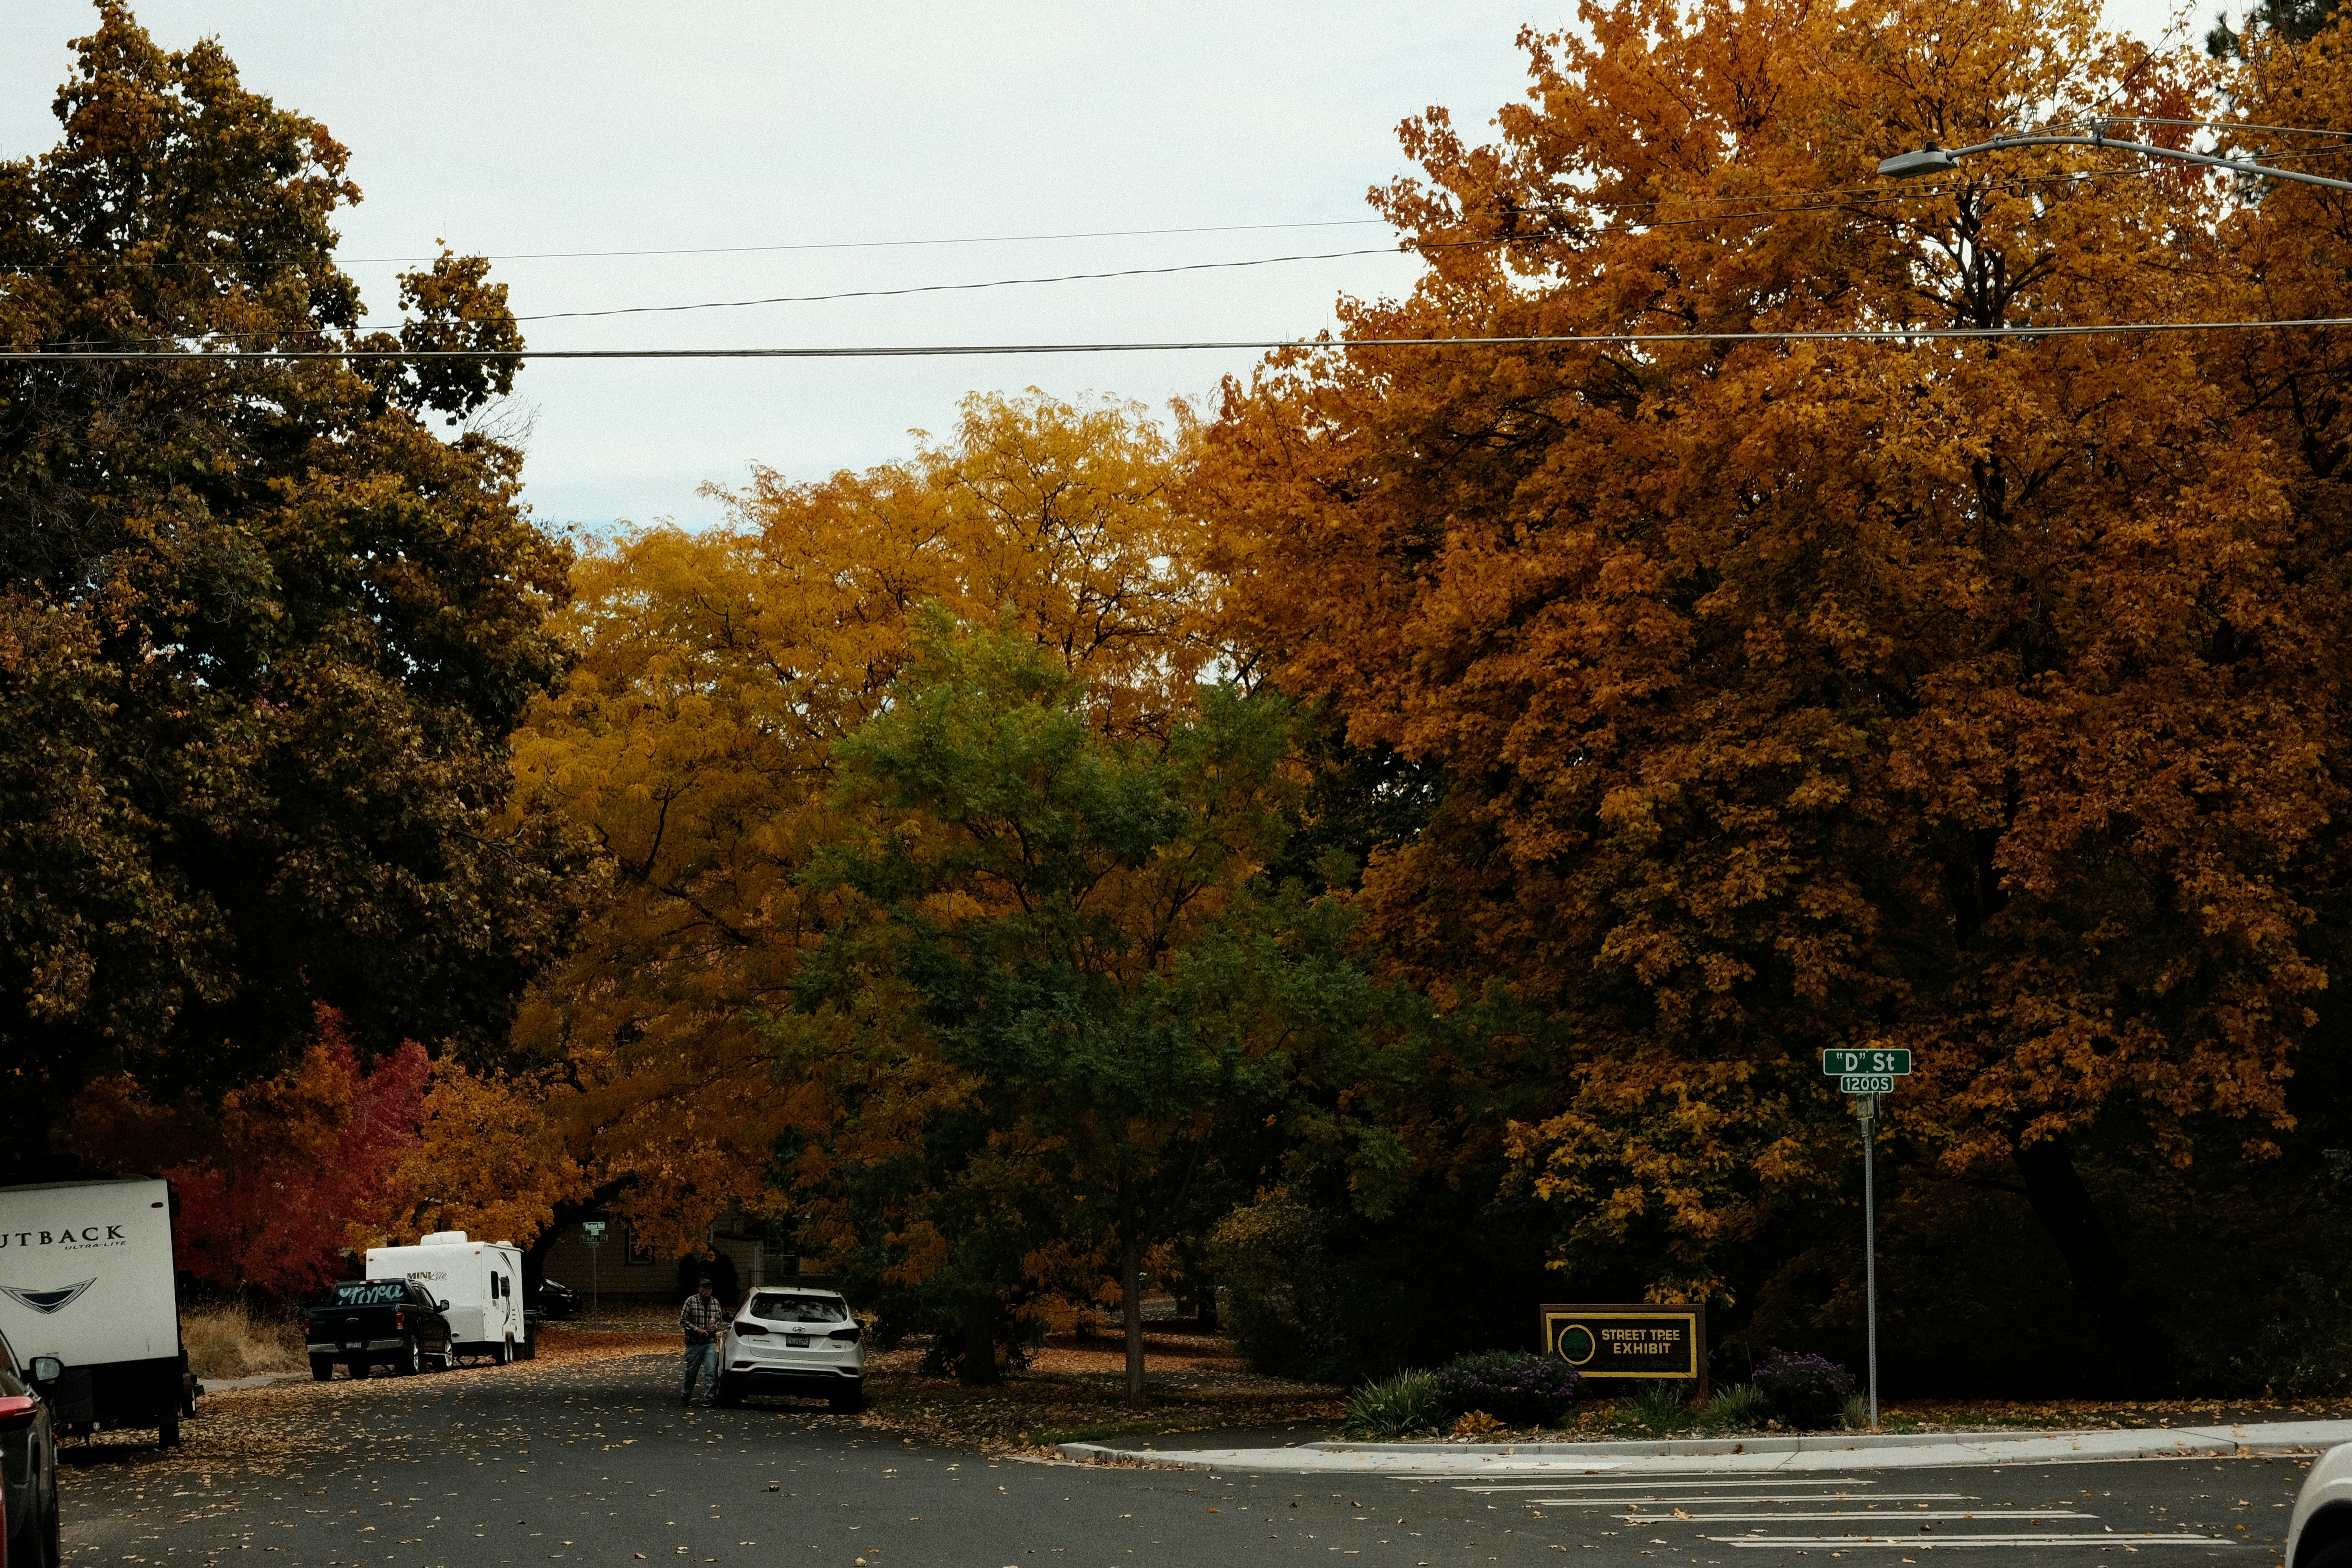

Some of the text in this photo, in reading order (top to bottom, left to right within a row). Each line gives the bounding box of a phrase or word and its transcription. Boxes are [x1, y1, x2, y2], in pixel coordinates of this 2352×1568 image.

[1836, 1052, 1894, 1071] "D" St
[1846, 1077, 1889, 1090] 1200S
[65, 1240, 126, 1250] ULTRA-LITE
[1602, 1329, 1680, 1341] STREET TREE
[1613, 1343, 1671, 1354] EXHIBIT
